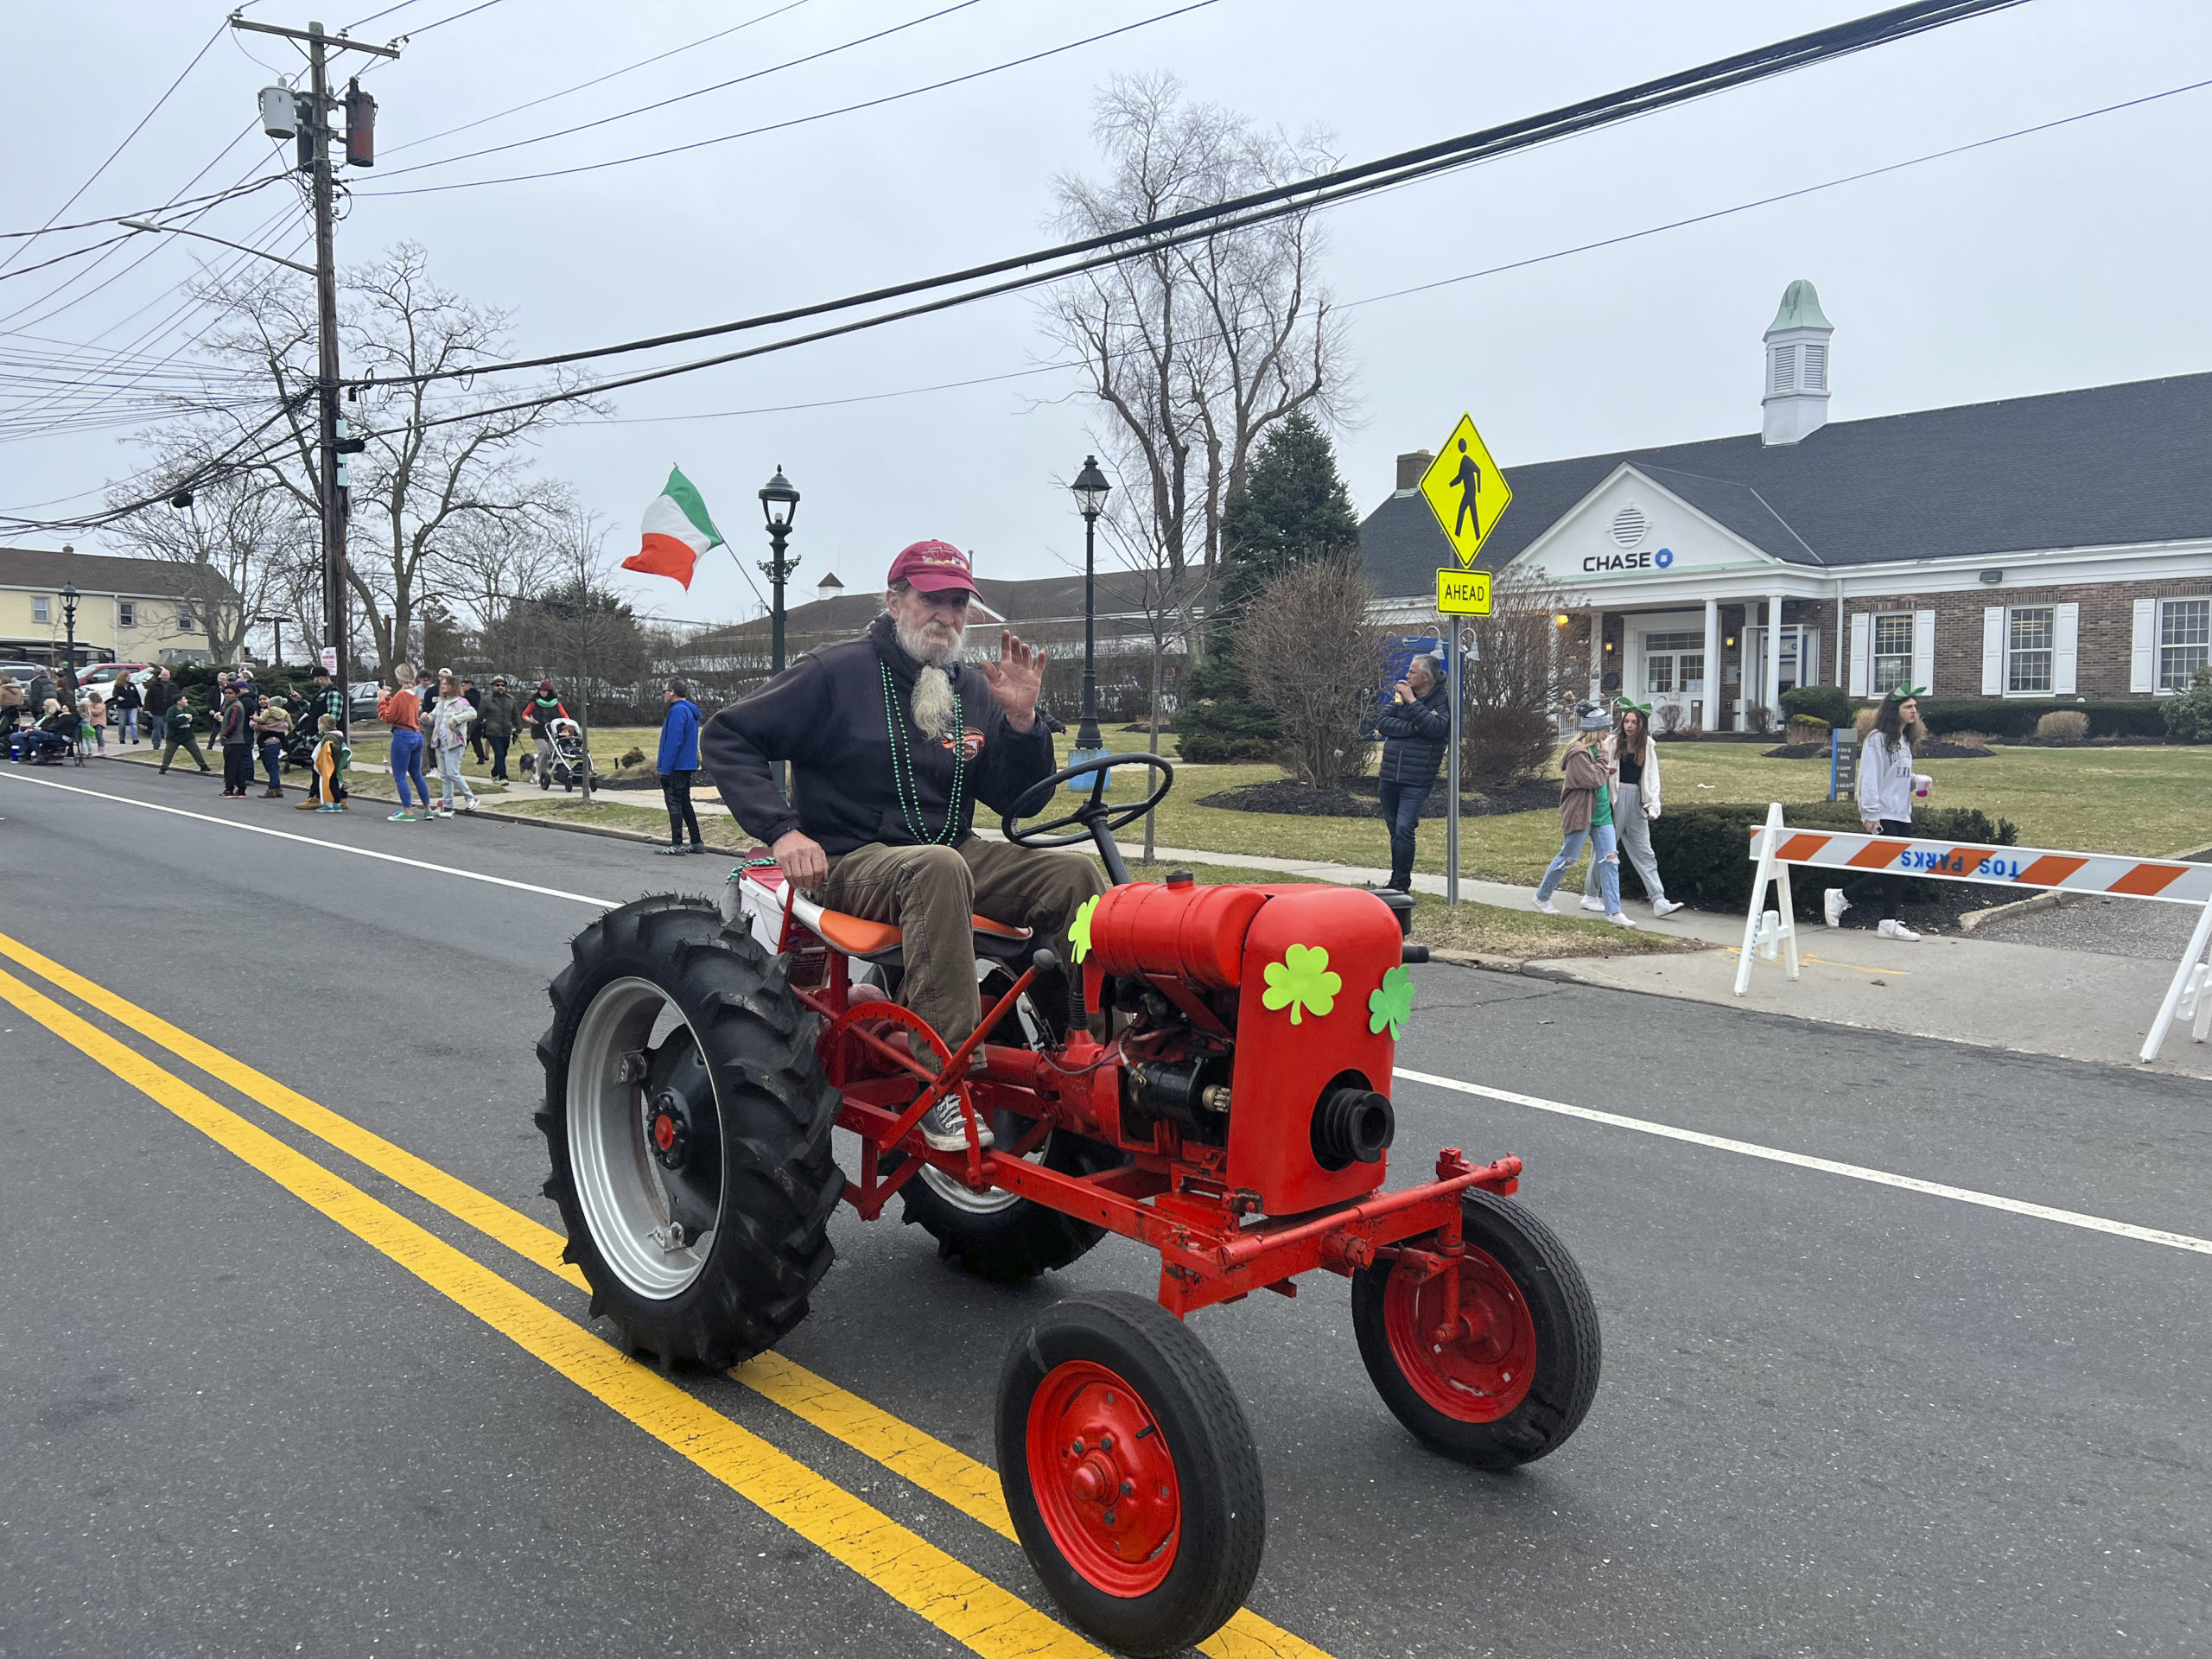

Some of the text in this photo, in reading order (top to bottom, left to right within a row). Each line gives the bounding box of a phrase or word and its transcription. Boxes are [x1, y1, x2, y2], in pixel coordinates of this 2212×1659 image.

[1583, 552, 1651, 572] CHASE
[1445, 584, 1484, 601] AHEAD
[1901, 851, 2020, 879] TOS PARKS
